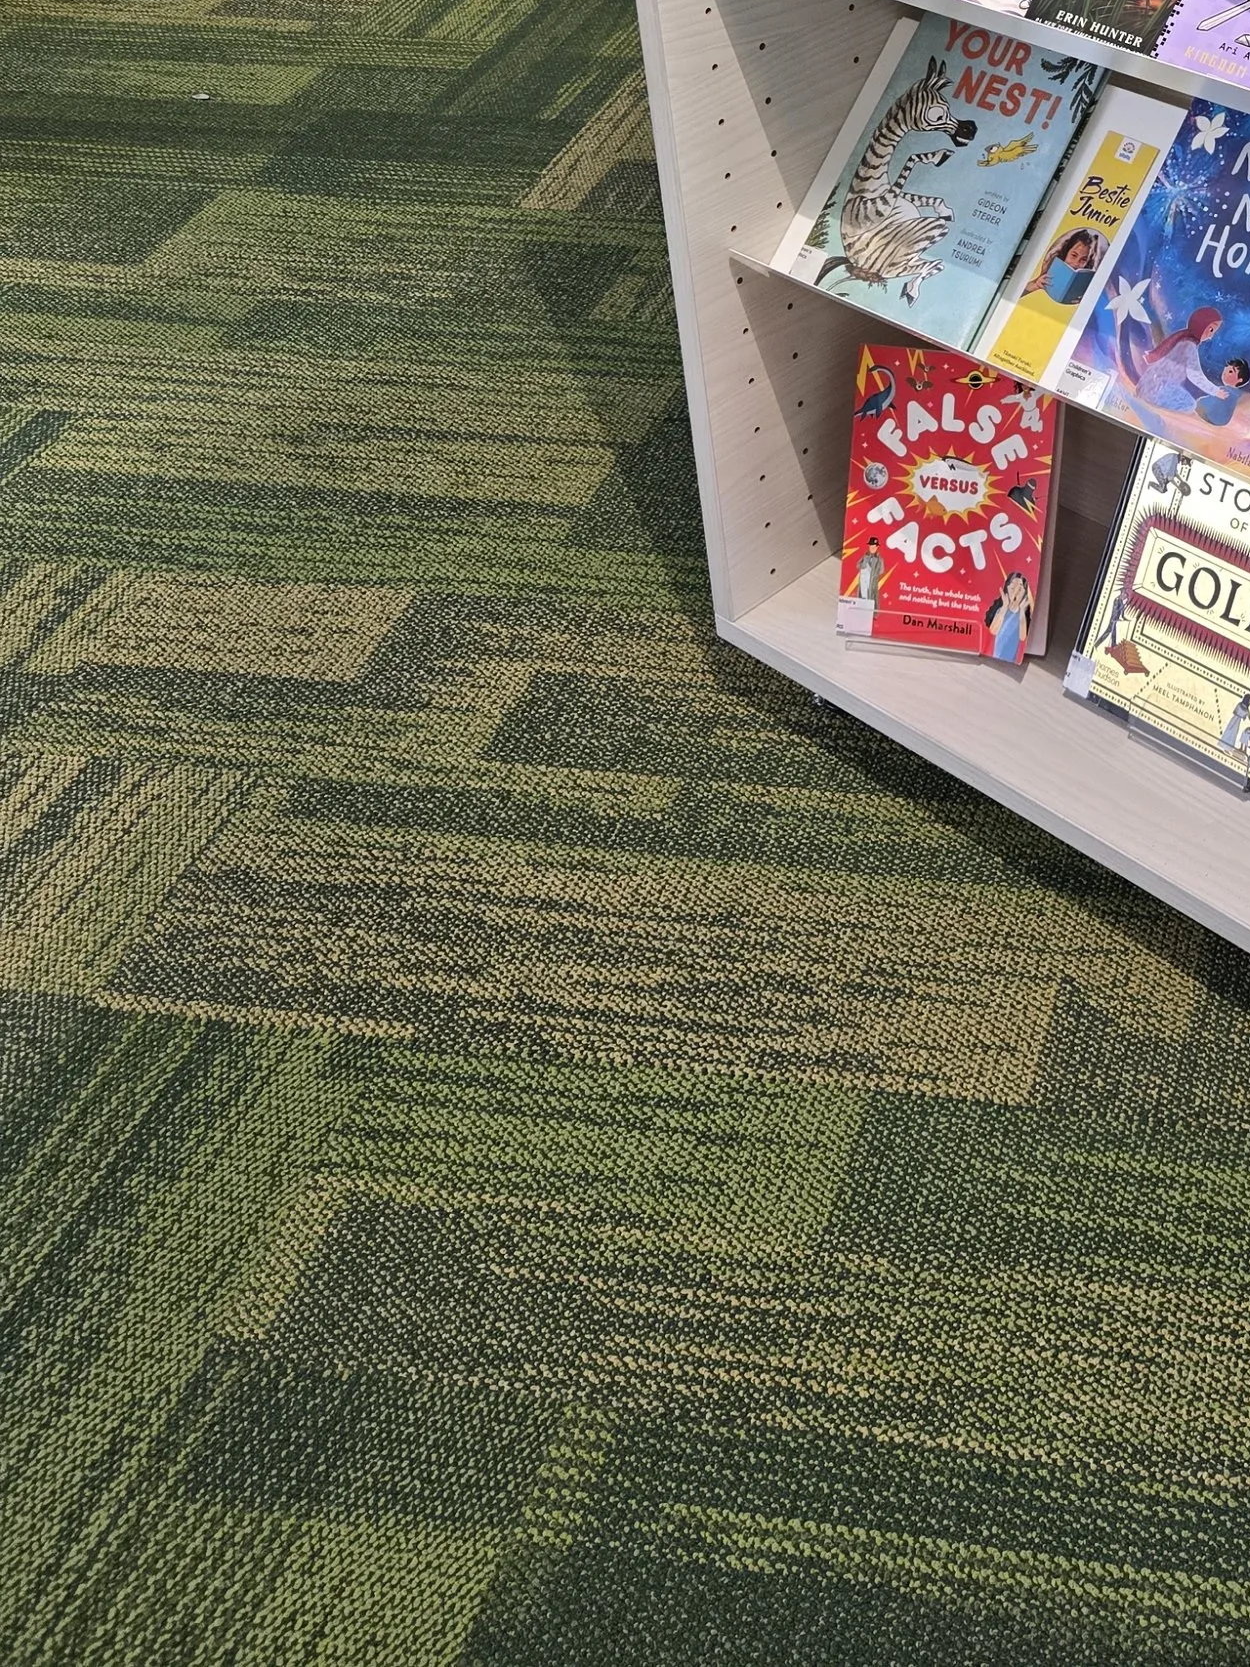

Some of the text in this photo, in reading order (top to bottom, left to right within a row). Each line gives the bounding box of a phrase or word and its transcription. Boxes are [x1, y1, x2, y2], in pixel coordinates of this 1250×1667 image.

[1056, 10, 1088, 28] ERIN
[1090, 21, 1143, 48] HUNTER
[944, 19, 1031, 76] YOUR
[1219, 42, 1238, 56] Ari
[1184, 45, 1248, 79] KINGDOM
[952, 66, 1063, 130] NEST!
[1079, 175, 1131, 210] Bestie
[972, 209, 1001, 226] STERER
[977, 198, 1008, 215] GIDEON
[1069, 196, 1121, 228] Junior
[951, 248, 982, 268] TSURUMI
[957, 239, 986, 256] ANDREA
[1068, 361, 1092, 376] Children's
[877, 393, 1028, 470] FALSE
[919, 473, 979, 495] VERSUS
[866, 496, 1022, 573] FACTS
[1230, 516, 1249, 534] OF
[899, 582, 982, 602] The truth, the whole truth
[899, 594, 980, 612] and nothing but the truth
[903, 614, 973, 636] Dan Marshall
[1153, 684, 1215, 722] MEEL TAMPHANON
[1166, 682, 1206, 706] ILLUSTRATED BY
